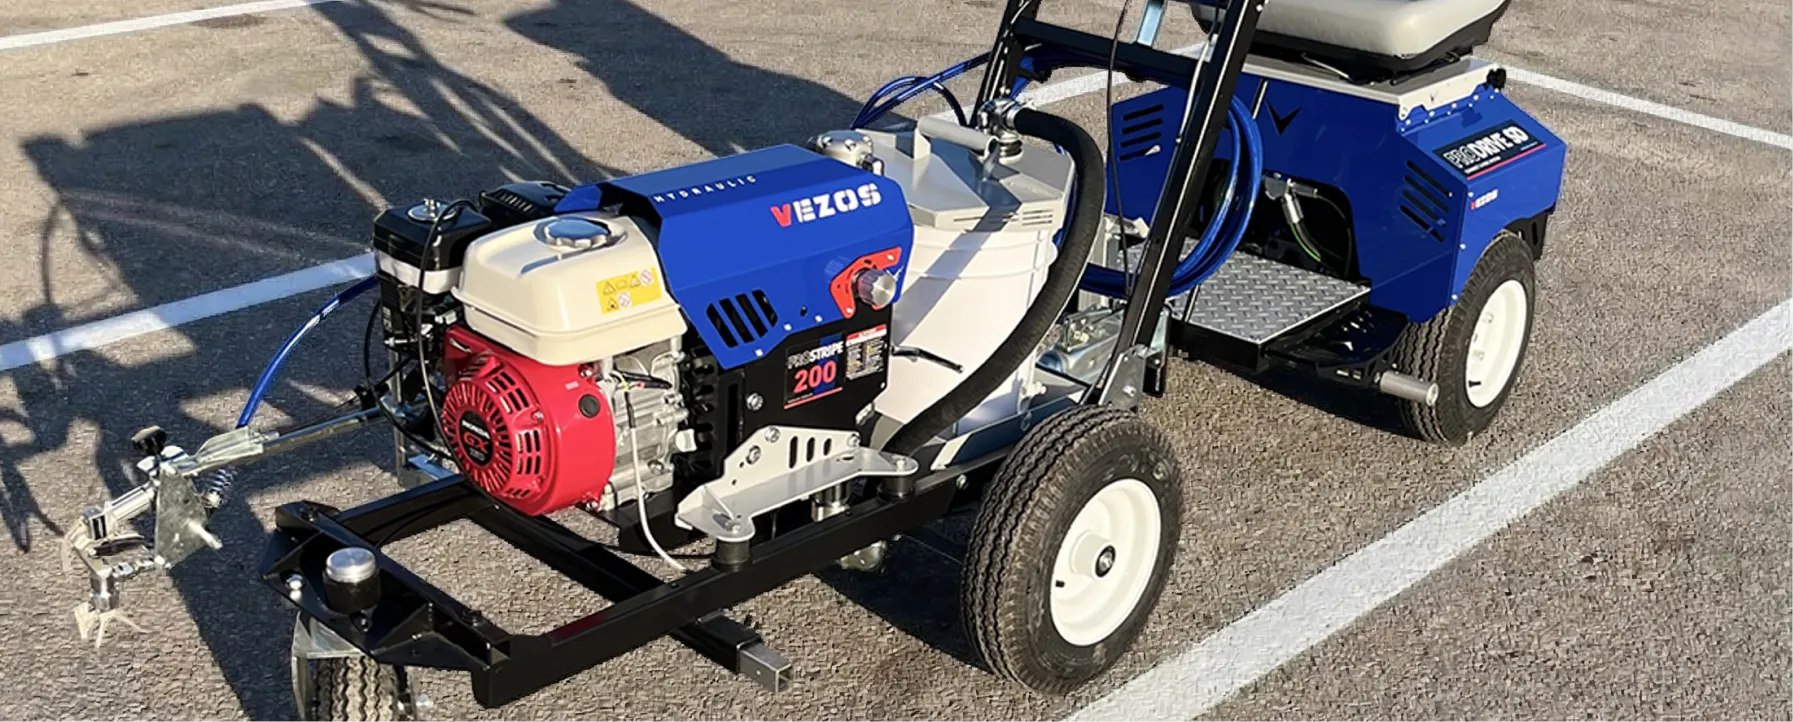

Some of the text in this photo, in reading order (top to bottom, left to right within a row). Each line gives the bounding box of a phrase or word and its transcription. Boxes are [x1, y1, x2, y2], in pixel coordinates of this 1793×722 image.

[1443, 132, 1514, 169] PRODRIVE
[653, 175, 756, 203] HYDRAULIC
[770, 182, 882, 228] VEZOS
[793, 360, 837, 394] 200
[463, 431, 490, 454] GX
